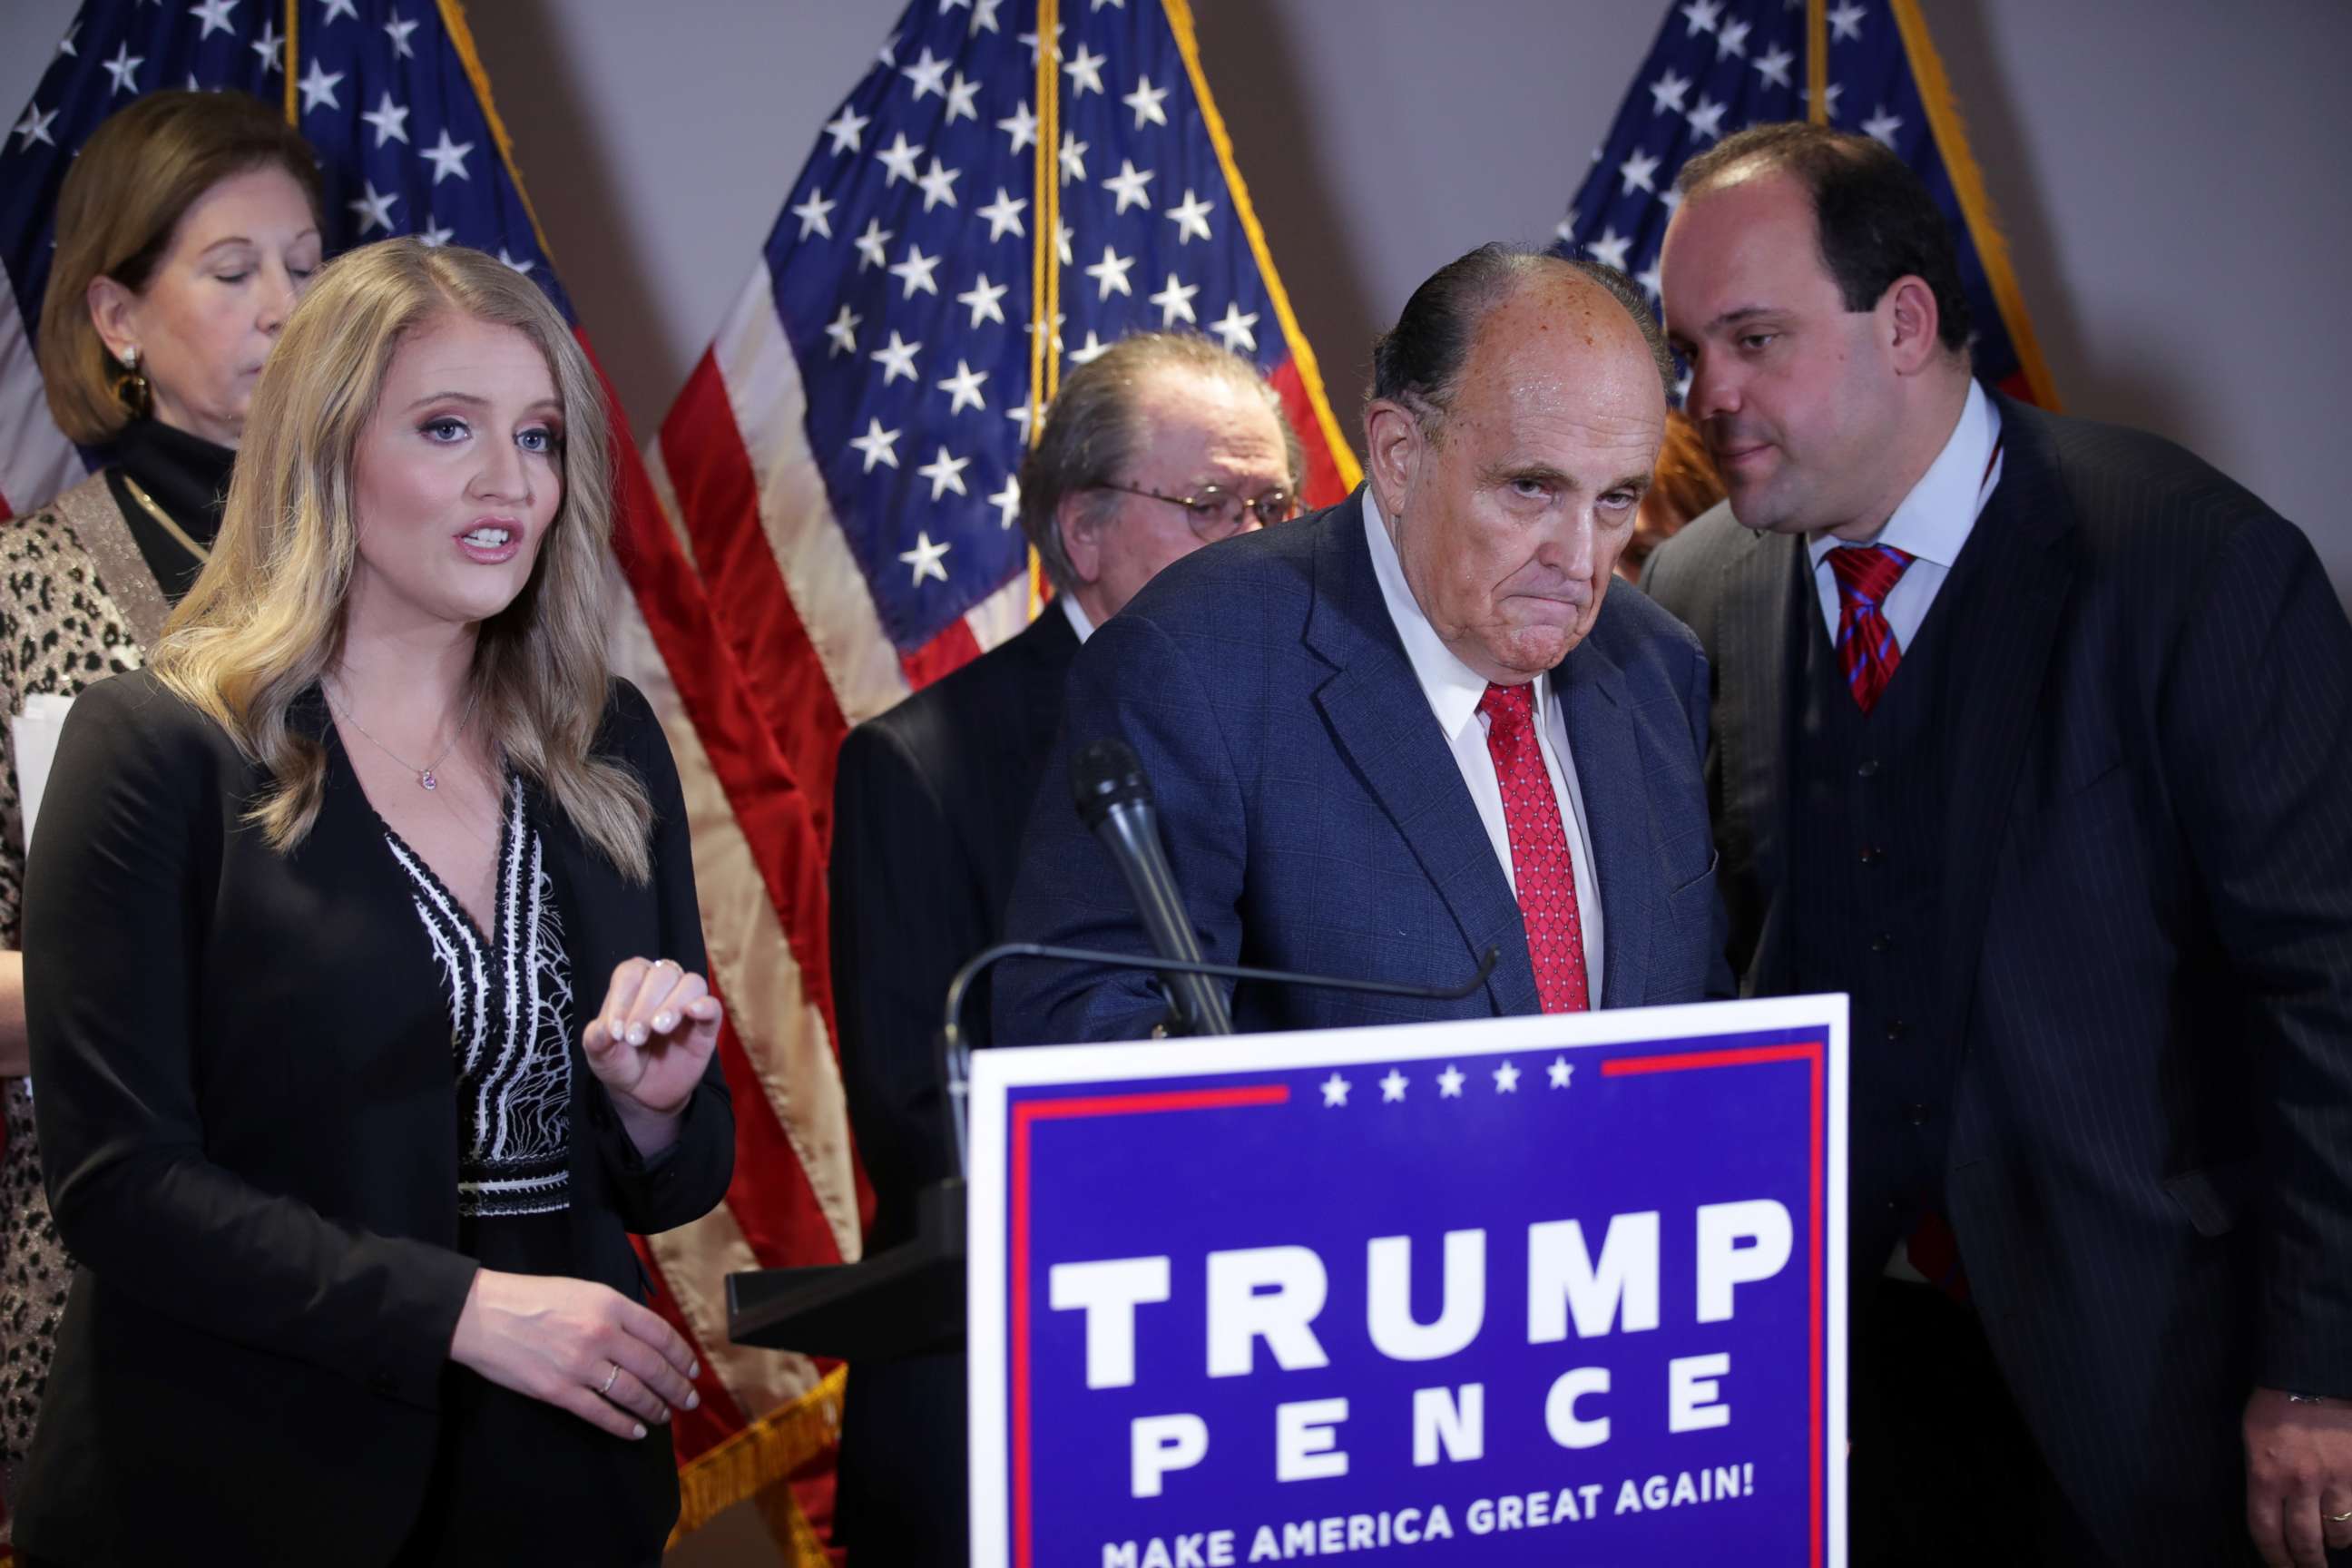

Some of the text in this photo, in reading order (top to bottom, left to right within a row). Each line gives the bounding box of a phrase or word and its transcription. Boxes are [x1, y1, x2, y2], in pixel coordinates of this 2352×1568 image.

[1049, 1199, 1794, 1389] TRUMP
[1131, 1352, 1730, 1498] PENCE
[1102, 1463, 1753, 1568] MAKE AMERICA GREAT AGAIN!
